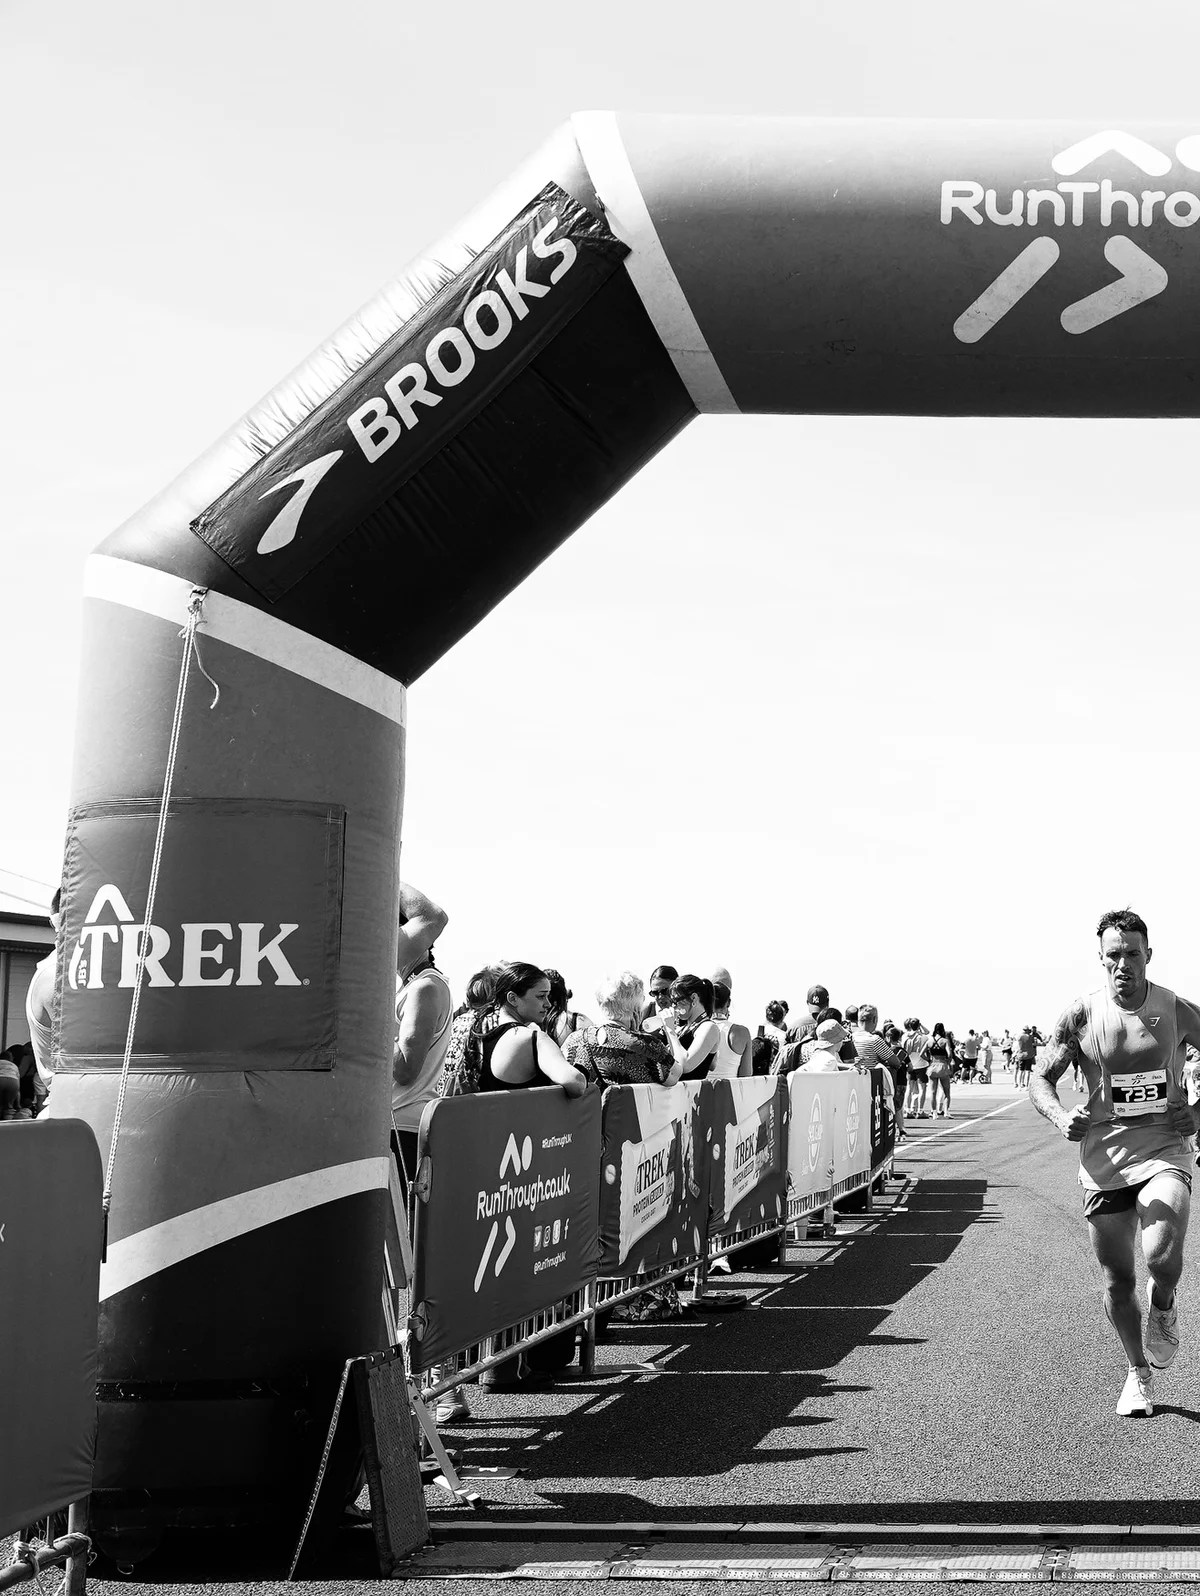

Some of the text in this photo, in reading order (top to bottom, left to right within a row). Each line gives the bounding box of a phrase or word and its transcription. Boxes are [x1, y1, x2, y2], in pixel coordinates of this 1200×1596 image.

[346, 216, 577, 463] BROOKS
[80, 922, 302, 988] TREK
[1121, 1084, 1158, 1103] 733
[636, 1148, 665, 1194] TREK
[735, 1133, 755, 1170] TREK
[476, 1167, 571, 1221] RunThrough.co.uk
